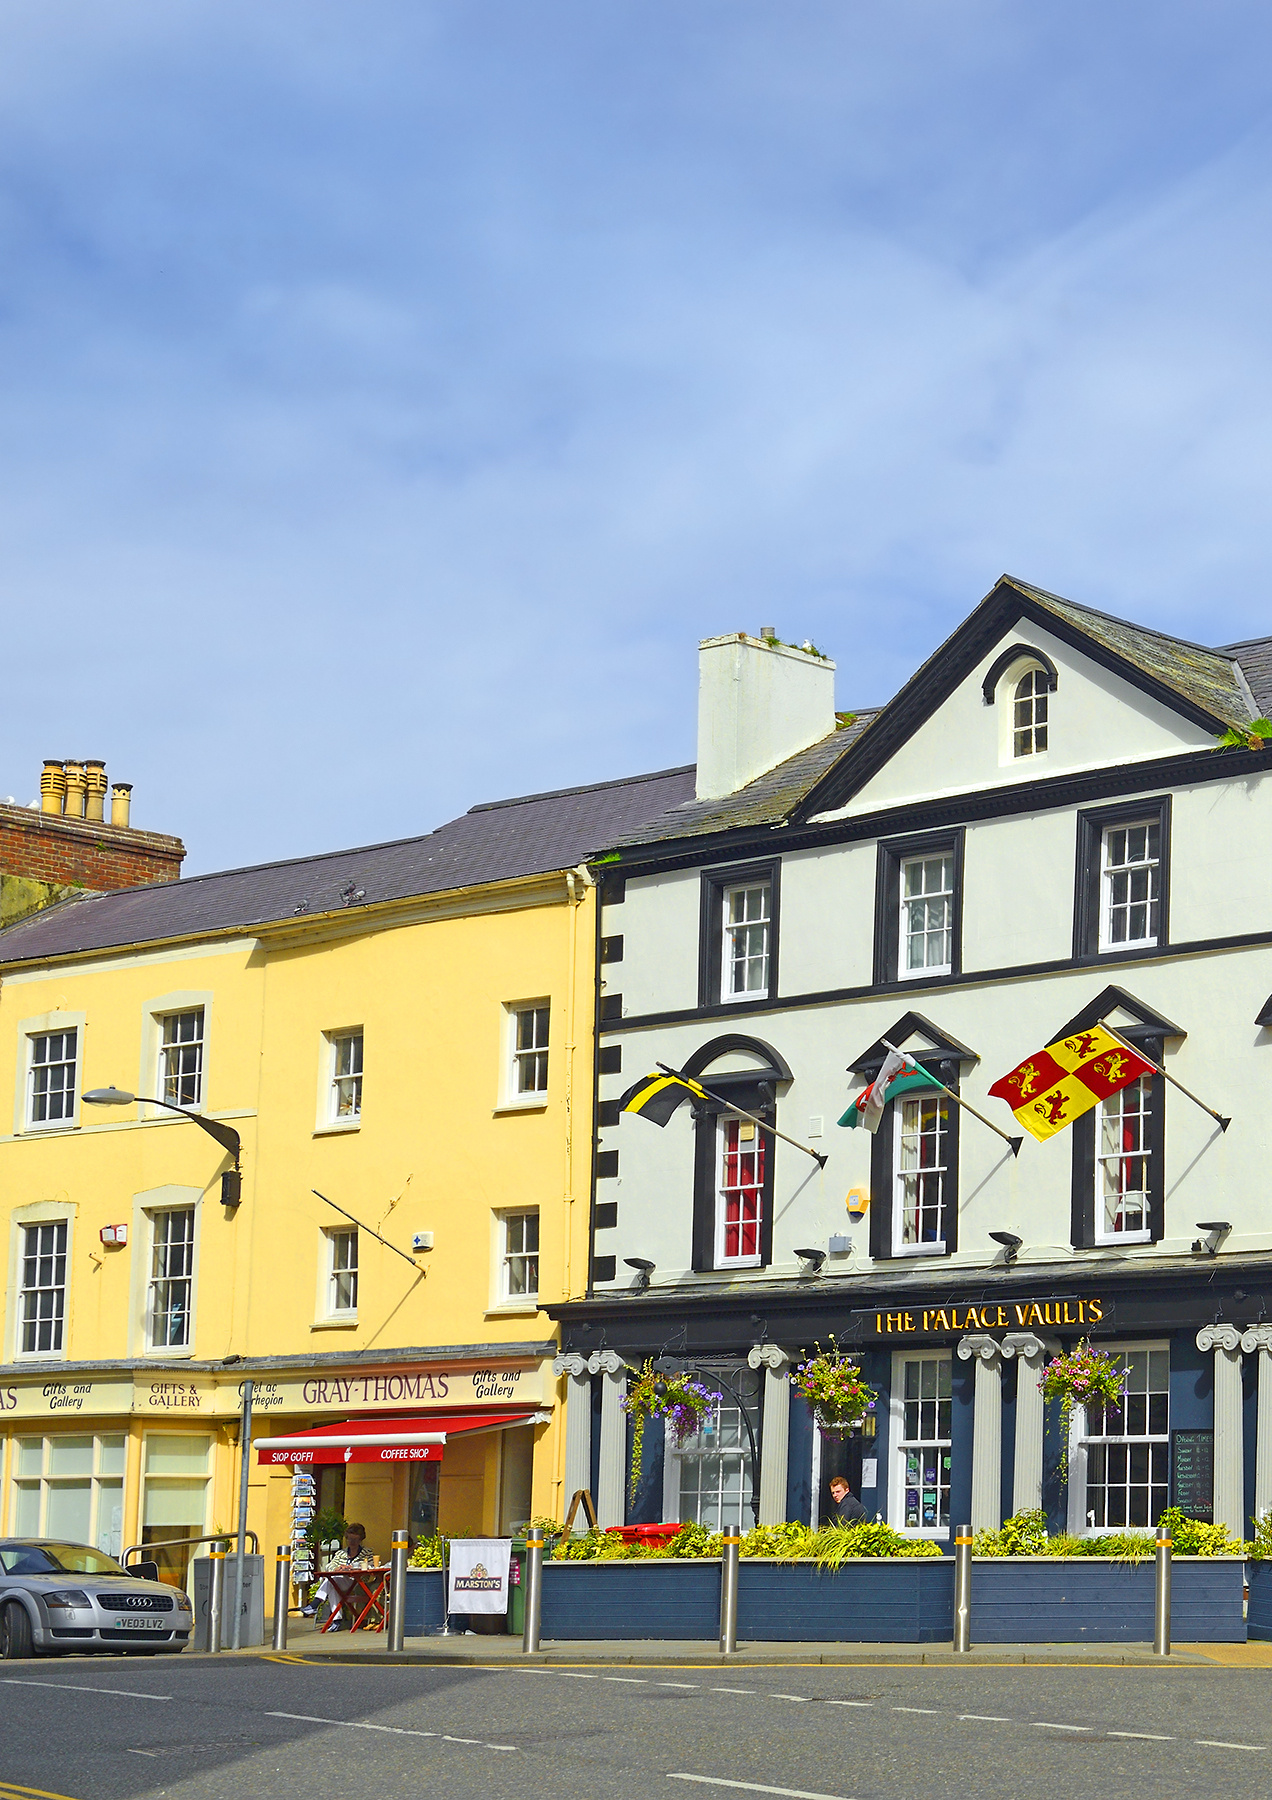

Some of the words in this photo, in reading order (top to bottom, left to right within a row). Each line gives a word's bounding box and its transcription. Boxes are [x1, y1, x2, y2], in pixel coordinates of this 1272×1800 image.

[876, 1312, 916, 1334] THE
[923, 1306, 1010, 1332] PALACE
[1015, 1299, 1104, 1327] VAULTS
[472, 1370, 497, 1386] Gifts
[502, 1369, 521, 1382] and
[42, 1382, 67, 1397] Gifts
[73, 1382, 93, 1394] and
[150, 1383, 185, 1395] GIFTS
[189, 1384, 197, 1395] &
[266, 1383, 277, 1392] ac
[476, 1383, 514, 1398] Gallery
[50, 1395, 83, 1409] Gallery
[149, 1395, 203, 1407] GALLERY
[237, 1393, 284, 1409] rhegion
[271, 1452, 289, 1462] SIOP
[290, 1451, 314, 1462] GOFFI
[381, 1449, 408, 1459] COFFEE
[409, 1448, 429, 1458] SHOP
[456, 1580, 501, 1589] MARSTON'S
[147, 1618, 164, 1629] LVZ
